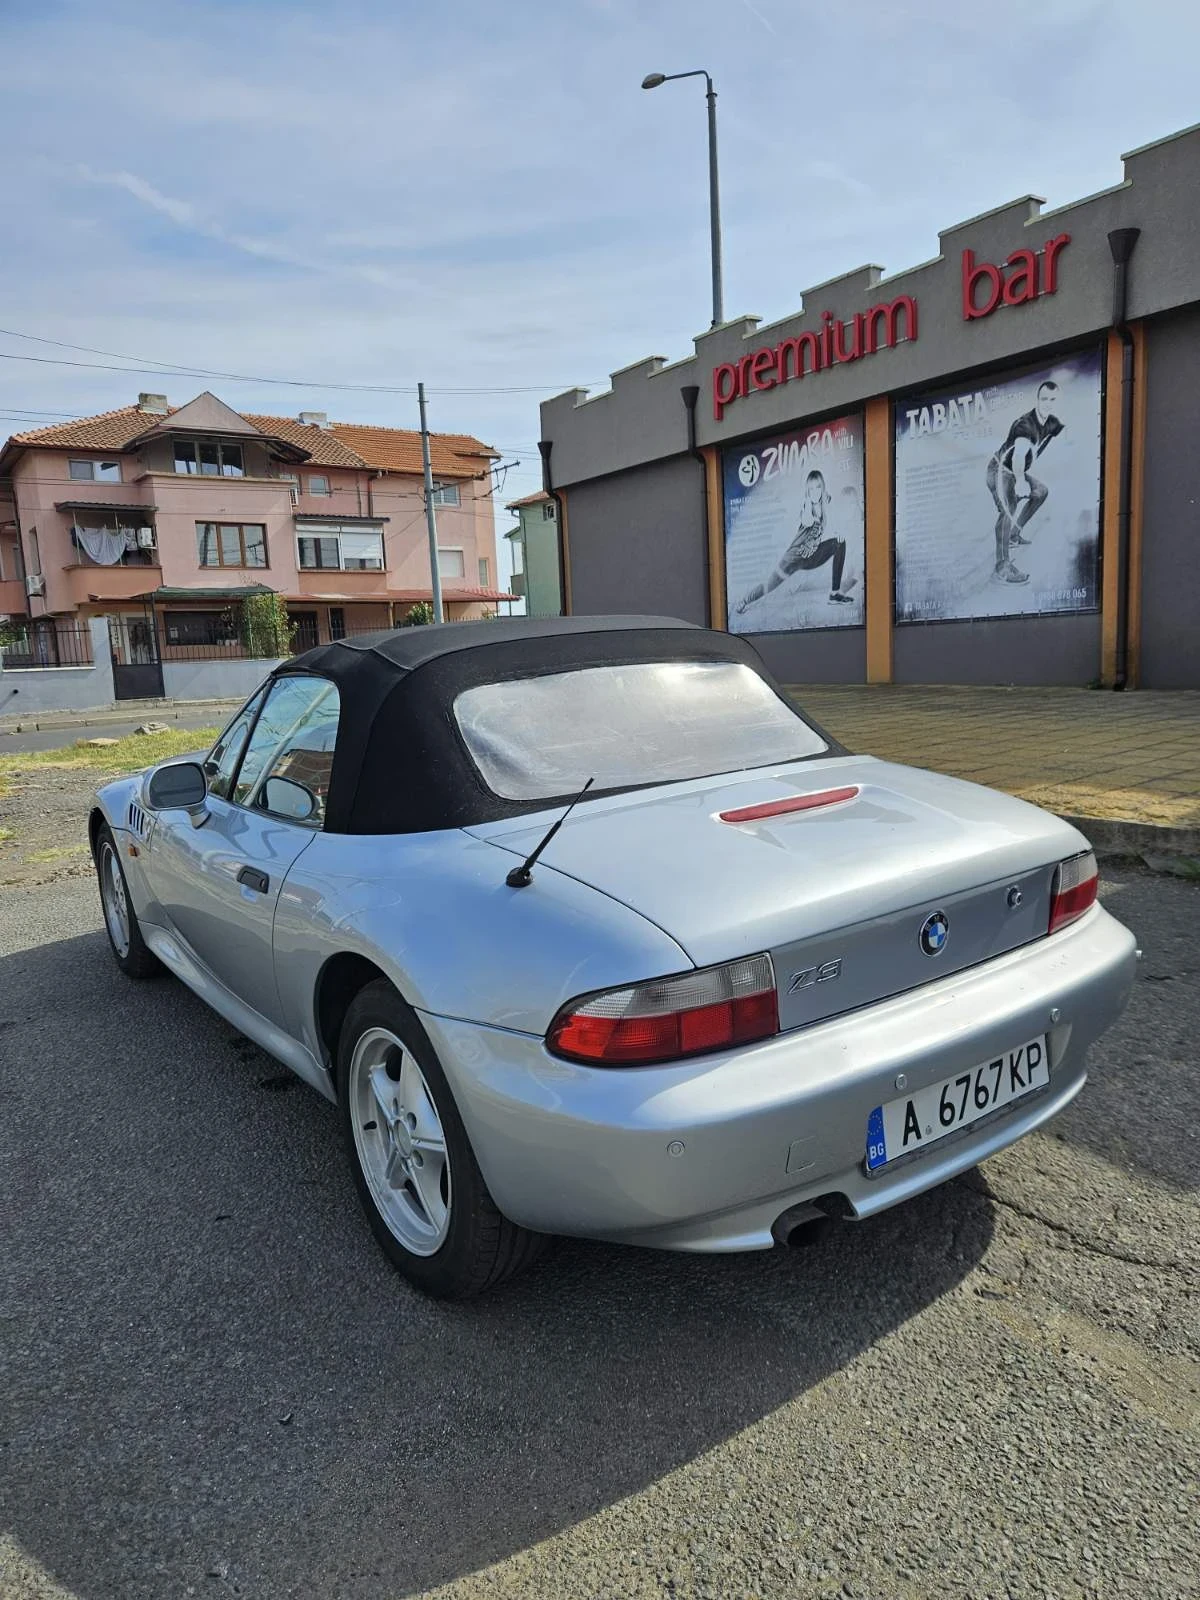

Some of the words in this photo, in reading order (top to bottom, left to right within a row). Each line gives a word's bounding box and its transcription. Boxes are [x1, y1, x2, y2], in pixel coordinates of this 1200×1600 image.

[713, 294, 918, 421] premium
[962, 233, 1071, 321] bar
[906, 391, 987, 439] TABATA
[1072, 587, 1087, 599] 065
[788, 958, 842, 995] Z3
[902, 1100, 922, 1146] A
[939, 1058, 1003, 1127] 6767
[1009, 1042, 1042, 1093] KP
[869, 1142, 885, 1161] BG
